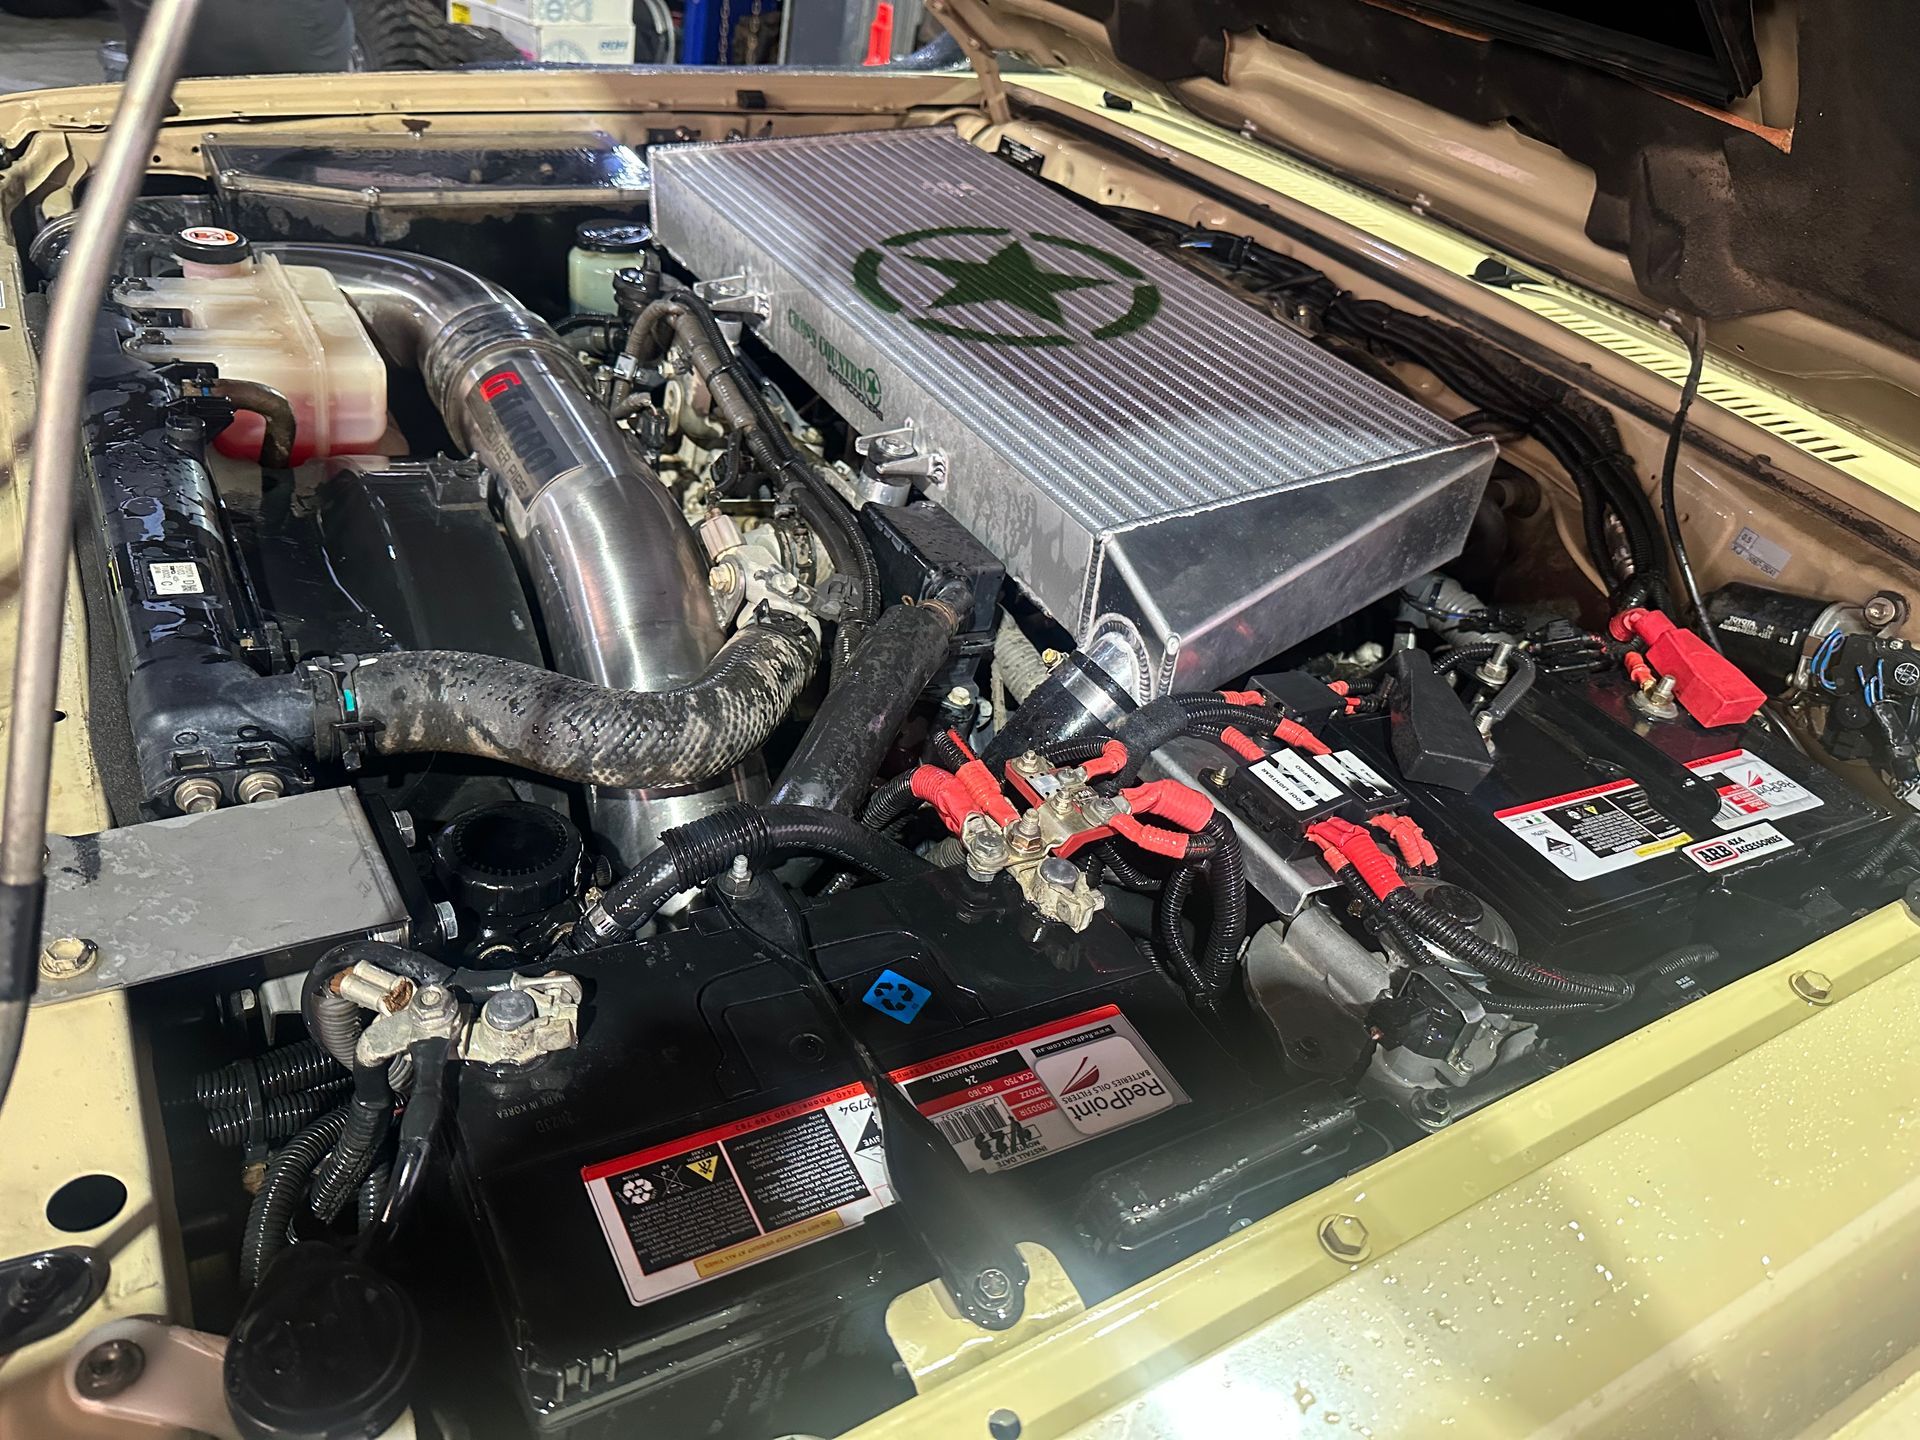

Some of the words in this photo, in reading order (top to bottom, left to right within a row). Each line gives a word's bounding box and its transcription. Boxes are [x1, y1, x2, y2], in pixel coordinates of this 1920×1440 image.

[1729, 616, 1757, 628] TOYOTA
[1261, 768, 1289, 792] LIGHTBAR
[1295, 764, 1319, 785] TOWPRO
[1727, 835, 1746, 847] 4X4
[1736, 834, 1783, 855] ACCESSORIES
[1699, 843, 1730, 863] ARB
[1033, 1025, 1112, 1056] www.RedPoint.com.au
[966, 1055, 998, 1070] MONTHS
[928, 1065, 970, 1083] WARRANTY
[962, 1074, 979, 1085] 24
[1001, 1075, 1019, 1086] 750
[1016, 1070, 1035, 1081] CCA
[1110, 1068, 1151, 1087] BATTERIES
[965, 1087, 983, 1098] 160
[979, 1084, 995, 1093] RC
[1017, 1084, 1045, 1099] N70ZZ
[1091, 1082, 1112, 1093] OILS
[1060, 1088, 1093, 1104] FILTERS
[1065, 1076, 1166, 1123] RedPoint
[1016, 1145, 1048, 1160] INSTALL
[994, 1155, 1017, 1167] DATE
[819, 1193, 855, 1209] WARRANTY
[774, 1206, 820, 1225] INFORMATION
